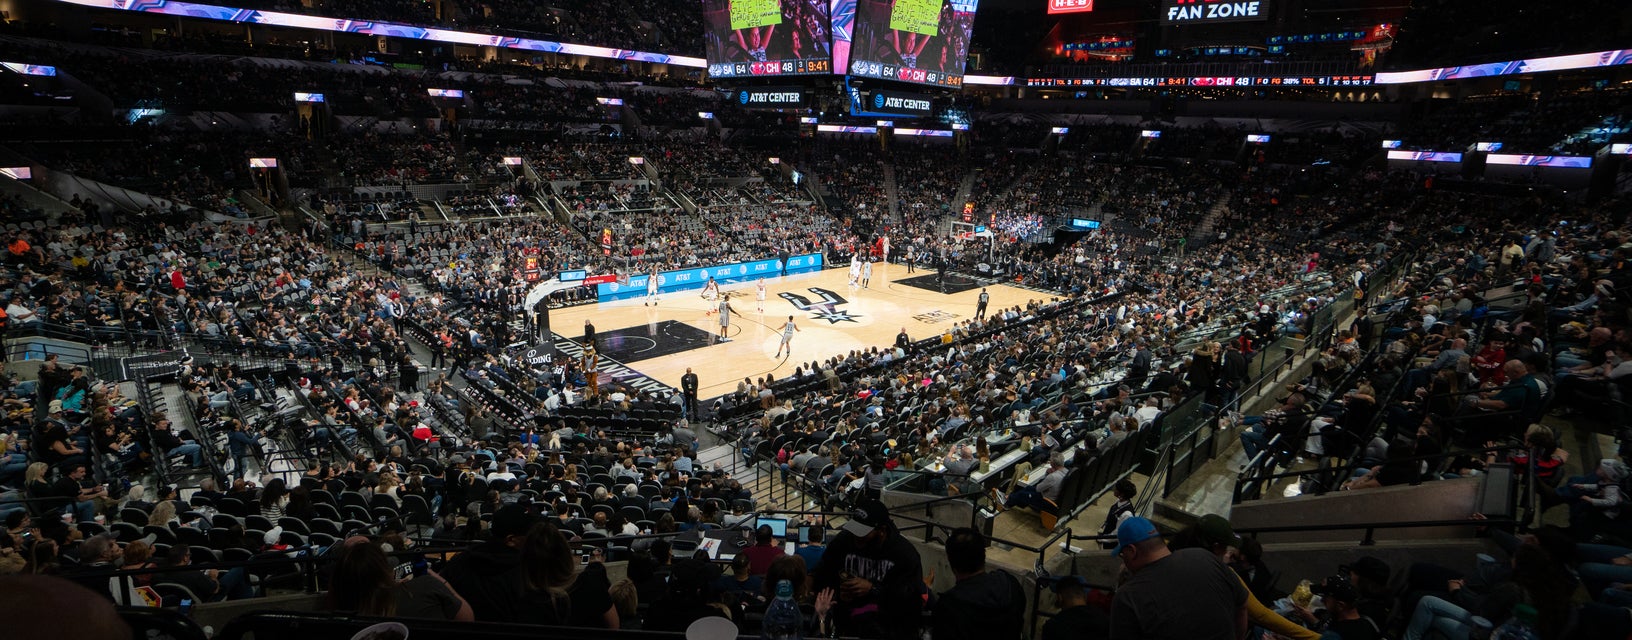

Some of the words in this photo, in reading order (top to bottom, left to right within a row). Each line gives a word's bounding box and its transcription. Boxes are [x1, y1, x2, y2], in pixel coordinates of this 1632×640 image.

[1168, 5, 1203, 20] FAN
[1207, 2, 1260, 18] ZONE
[723, 65, 734, 74] SA
[736, 64, 746, 74] 64
[766, 63, 780, 73] CHI
[782, 62, 793, 72] 48
[808, 60, 828, 71] 9:41
[869, 65, 879, 75] SA
[883, 66, 894, 77] 64
[913, 70, 925, 81] CHI
[926, 73, 936, 82] 48
[947, 75, 962, 86] 9:41
[1130, 78, 1142, 86] SA
[1143, 78, 1155, 86] 64
[1168, 77, 1186, 85] 9:41
[1217, 78, 1232, 86] CHI
[1235, 77, 1249, 85] 48
[750, 92, 768, 102] AT&T
[769, 92, 800, 102] CENTER
[885, 96, 903, 108] AT&T
[904, 98, 930, 110] CENTER
[789, 258, 802, 266] AT&T
[755, 263, 768, 271] AT&T
[717, 268, 731, 276] AT&T
[676, 272, 691, 282] AT&T
[630, 279, 647, 288] AT&T
